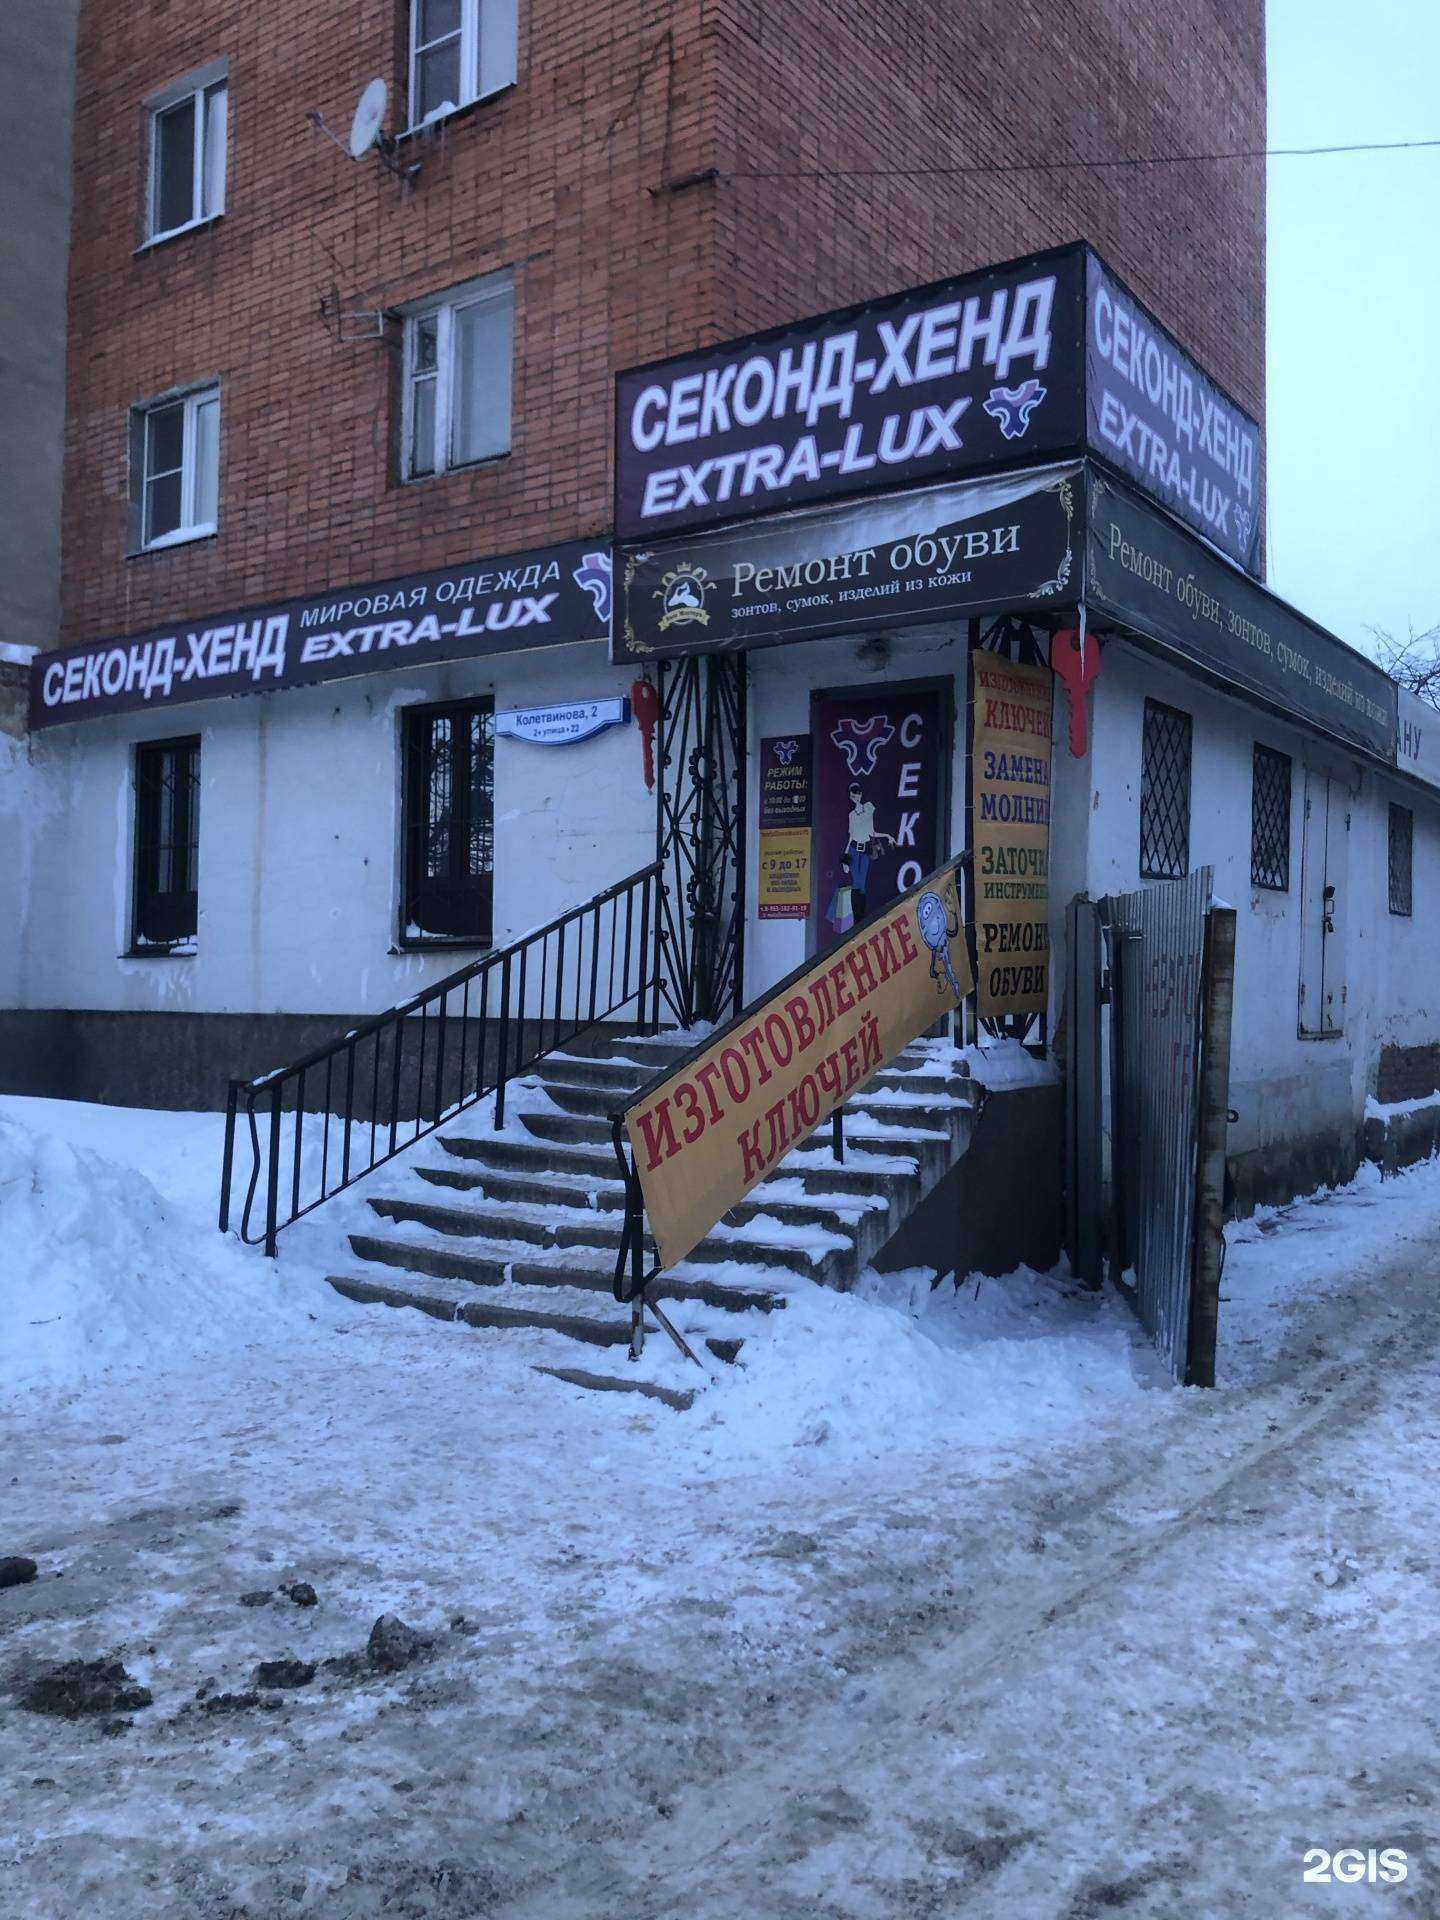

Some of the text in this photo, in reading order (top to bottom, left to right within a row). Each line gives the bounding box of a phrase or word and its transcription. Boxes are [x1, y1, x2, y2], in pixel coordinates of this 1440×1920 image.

[630, 275, 1057, 454] СЕКОНД-ХЕНД
[1093, 284, 1254, 506] СЕКОНД-ХЕНД
[640, 397, 973, 520] EXTRA-LUX
[1099, 390, 1232, 537] EXTRA-LUX
[300, 560, 561, 629] МИРОВАЯ ОДЕЖДА
[730, 570, 973, 619] зонтов, сумок, изделий из кожи
[731, 523, 1022, 598] Ремонт обуви
[300, 592, 560, 664] EXTRA-LUX
[1108, 522, 1173, 595] Ремонт
[1177, 573, 1224, 633] обуви,
[1228, 609, 1274, 663] зонтов,
[1276, 640, 1313, 688] сумок,
[43, 613, 291, 707] СЕКОНД-ХЕНД
[591, 705, 598, 718] 2
[764, 778, 808, 791] РАБОТЫ:
[767, 766, 804, 778] РЕЖИМ
[770, 859, 776, 870] 9
[779, 860, 792, 872] до
[795, 858, 807, 869] 17
[990, 964, 1045, 997] ОБУВИ
[636, 913, 919, 1172] ИЗГОТОВЛЕНИЕ
[737, 1009, 884, 1186] КЛЮЧЕЙ
